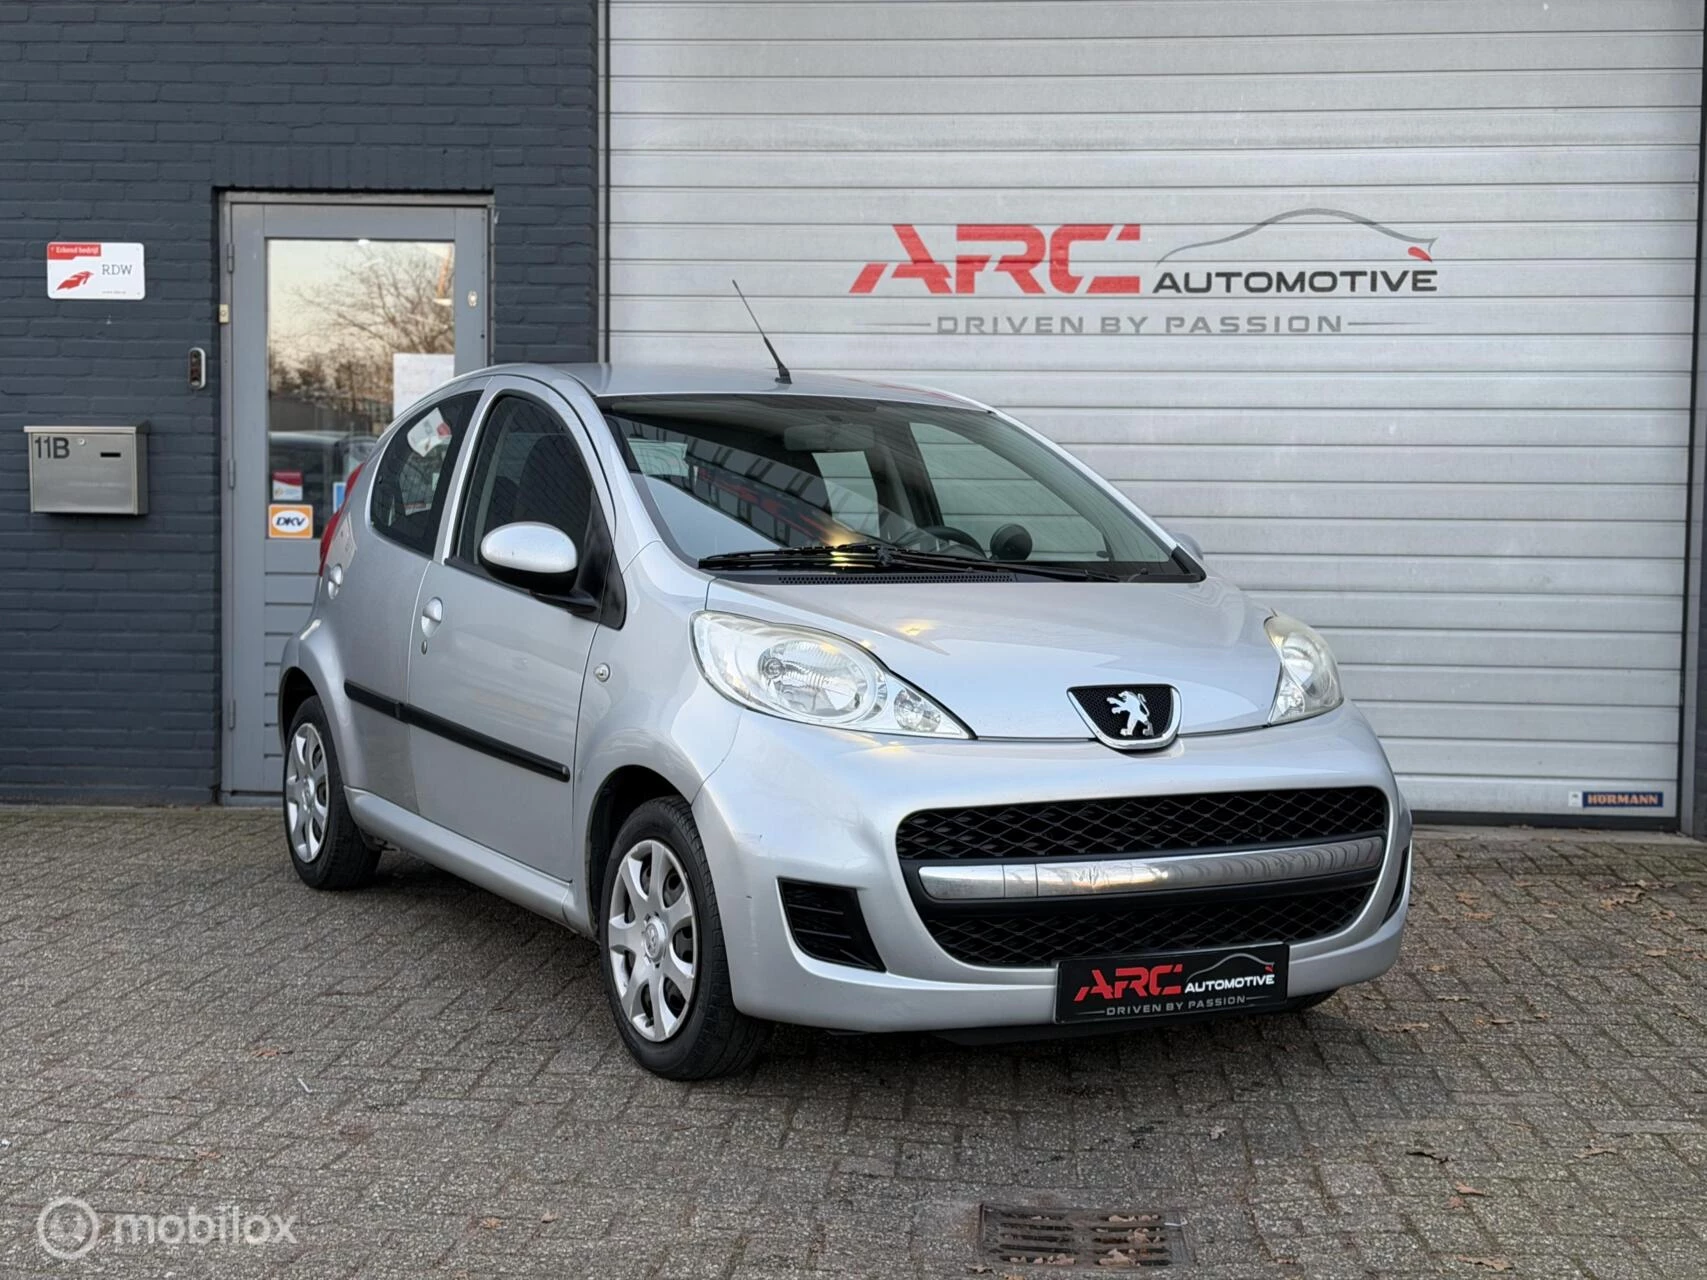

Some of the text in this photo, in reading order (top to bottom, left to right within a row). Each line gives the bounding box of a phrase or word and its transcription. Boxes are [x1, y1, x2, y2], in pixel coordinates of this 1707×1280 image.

[848, 223, 1141, 294] ARC
[102, 264, 132, 275] RDW
[1152, 270, 1437, 294] AUTOMOTIVE
[937, 315, 1341, 335] DRIVEN BY PASSION
[34, 436, 70, 459] 11B
[276, 516, 306, 527] DKV
[1074, 964, 1183, 1001] ARC
[1184, 974, 1275, 993] AUTOMOTIVE
[1106, 995, 1246, 1016] DRIVEN BY PASSION
